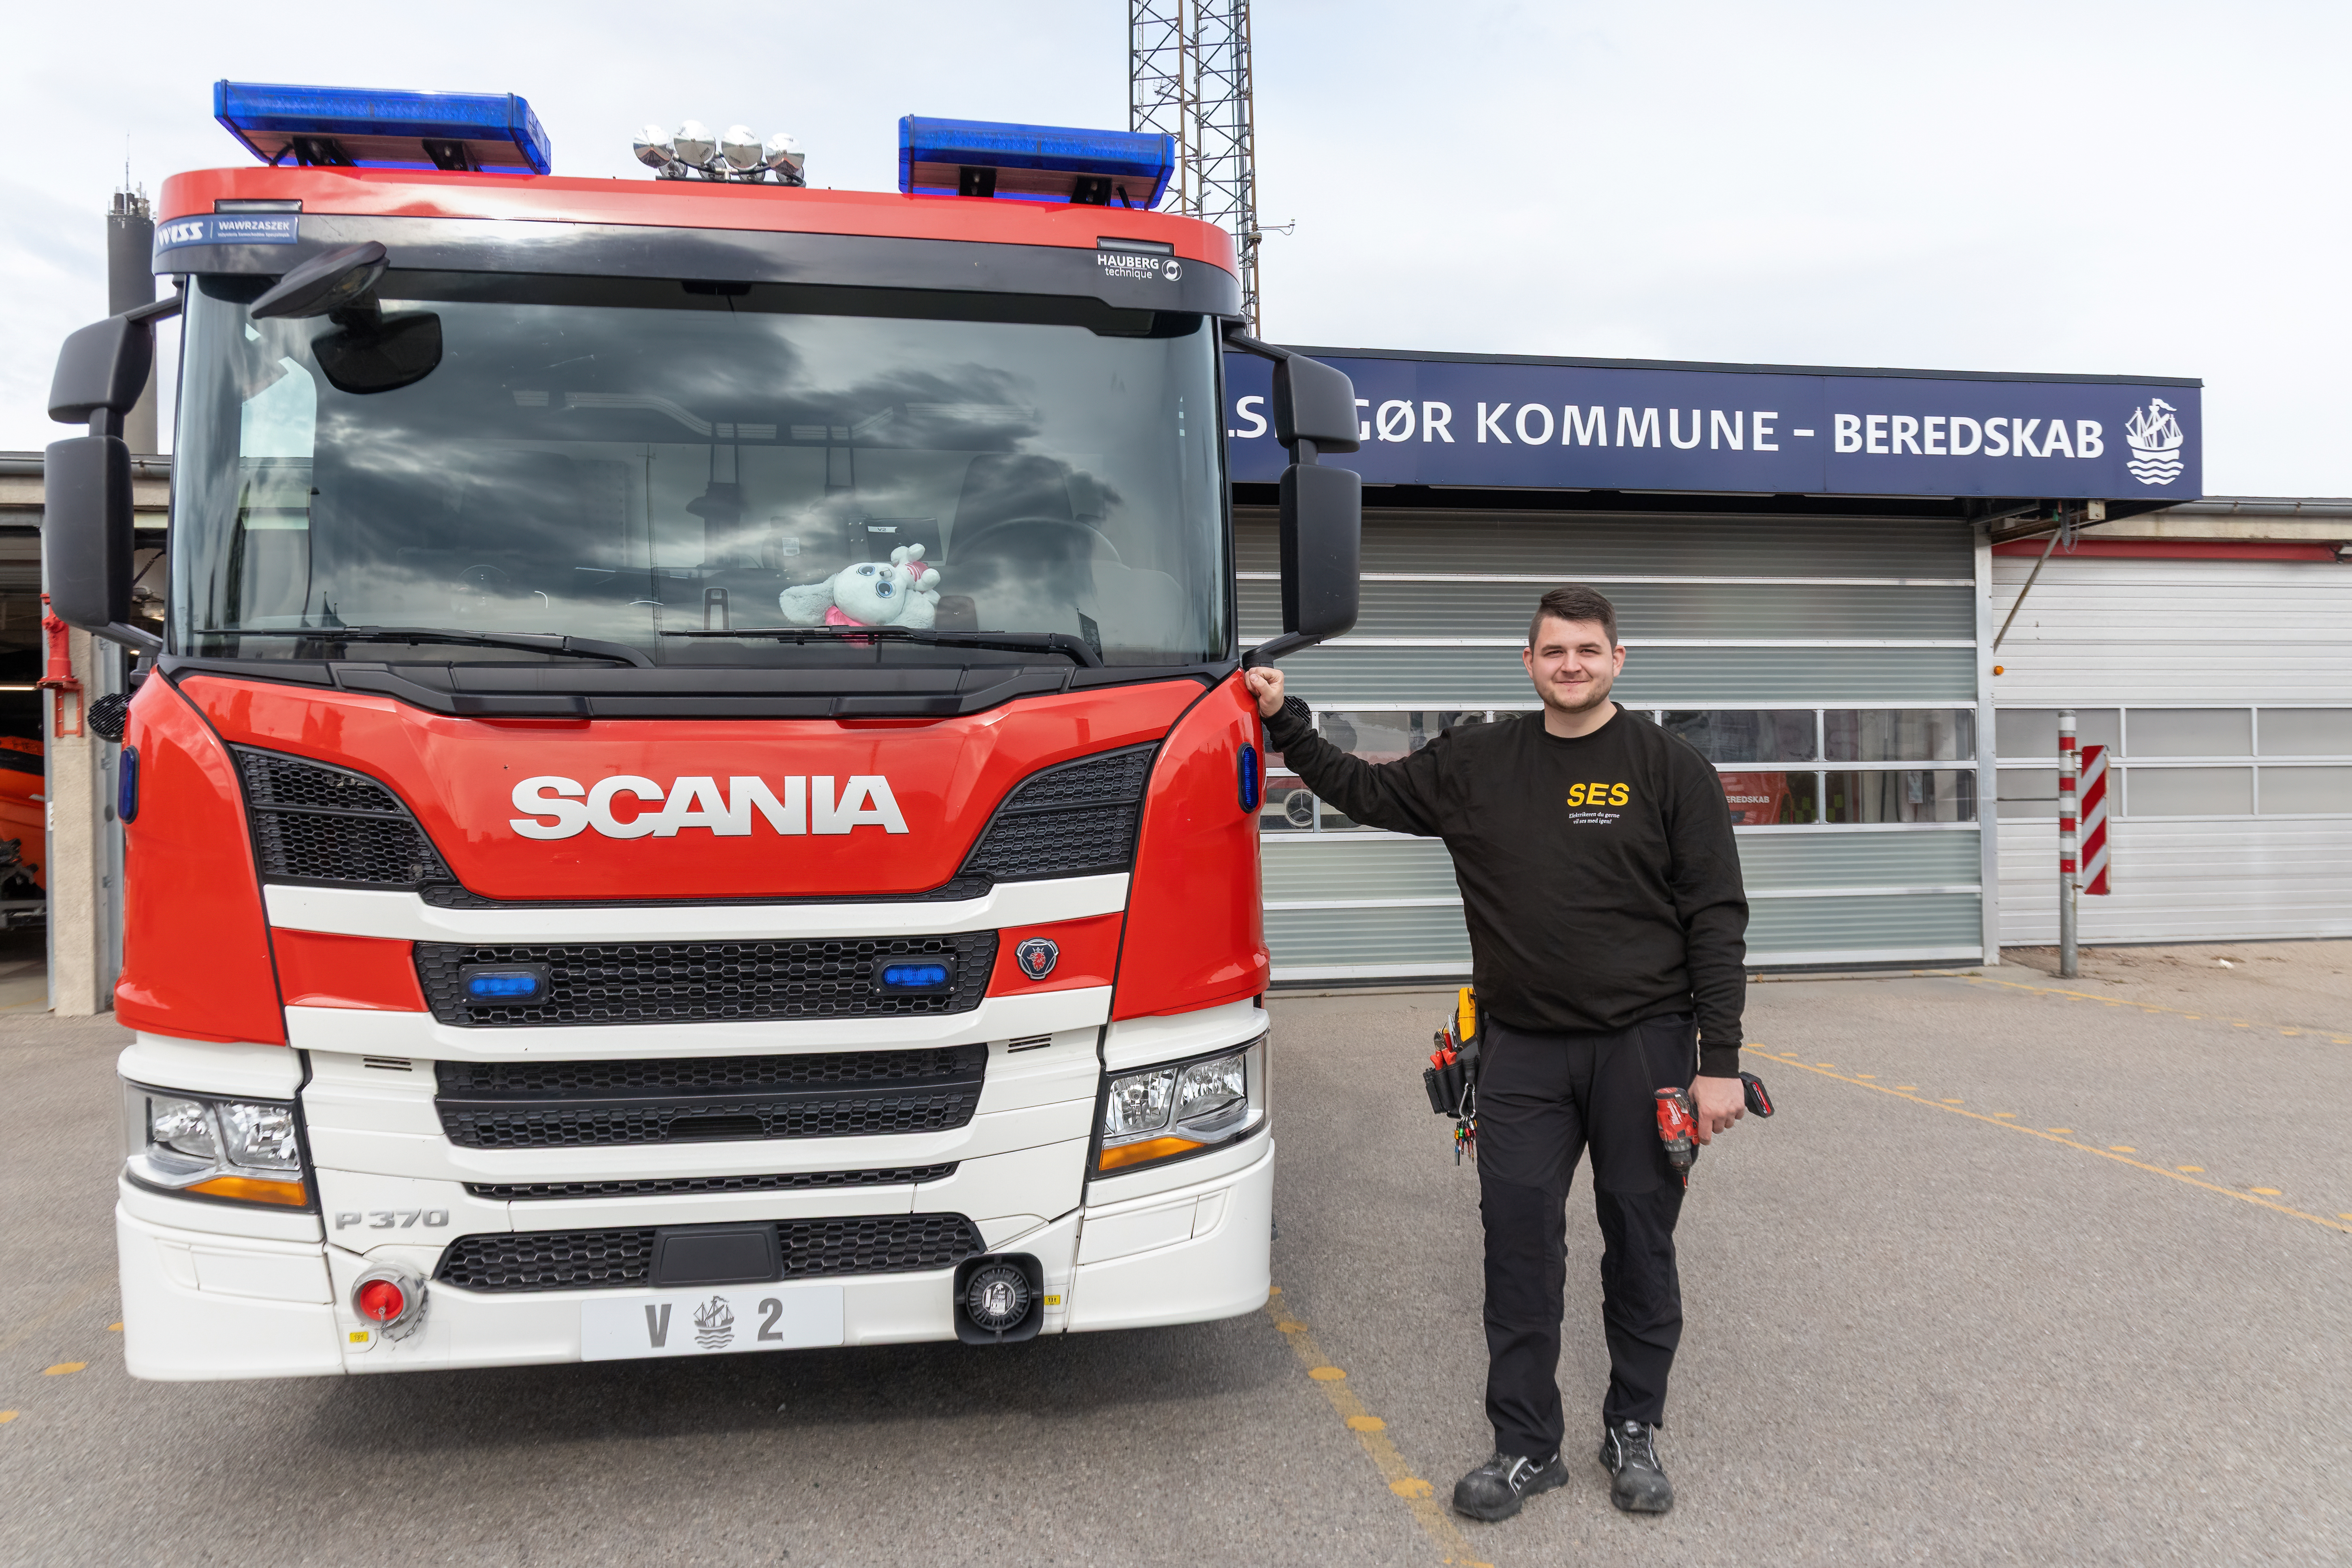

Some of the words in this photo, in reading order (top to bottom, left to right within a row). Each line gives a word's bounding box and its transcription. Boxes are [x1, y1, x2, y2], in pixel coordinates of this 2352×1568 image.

[218, 221, 290, 230] WAWRZASZEK
[1097, 254, 1159, 270] HAUBERG
[1105, 266, 1153, 280] technique
[1477, 402, 1779, 452] KOMMUNE
[1834, 414, 2104, 459] BEREDSKAB
[1567, 782, 1630, 807] SES
[1726, 795, 1770, 803] EREDSKAB
[509, 775, 910, 840] SCANIA
[335, 1210, 362, 1230] P
[368, 1208, 449, 1229] 370
[645, 1303, 673, 1349] V
[757, 1298, 783, 1342] 2
